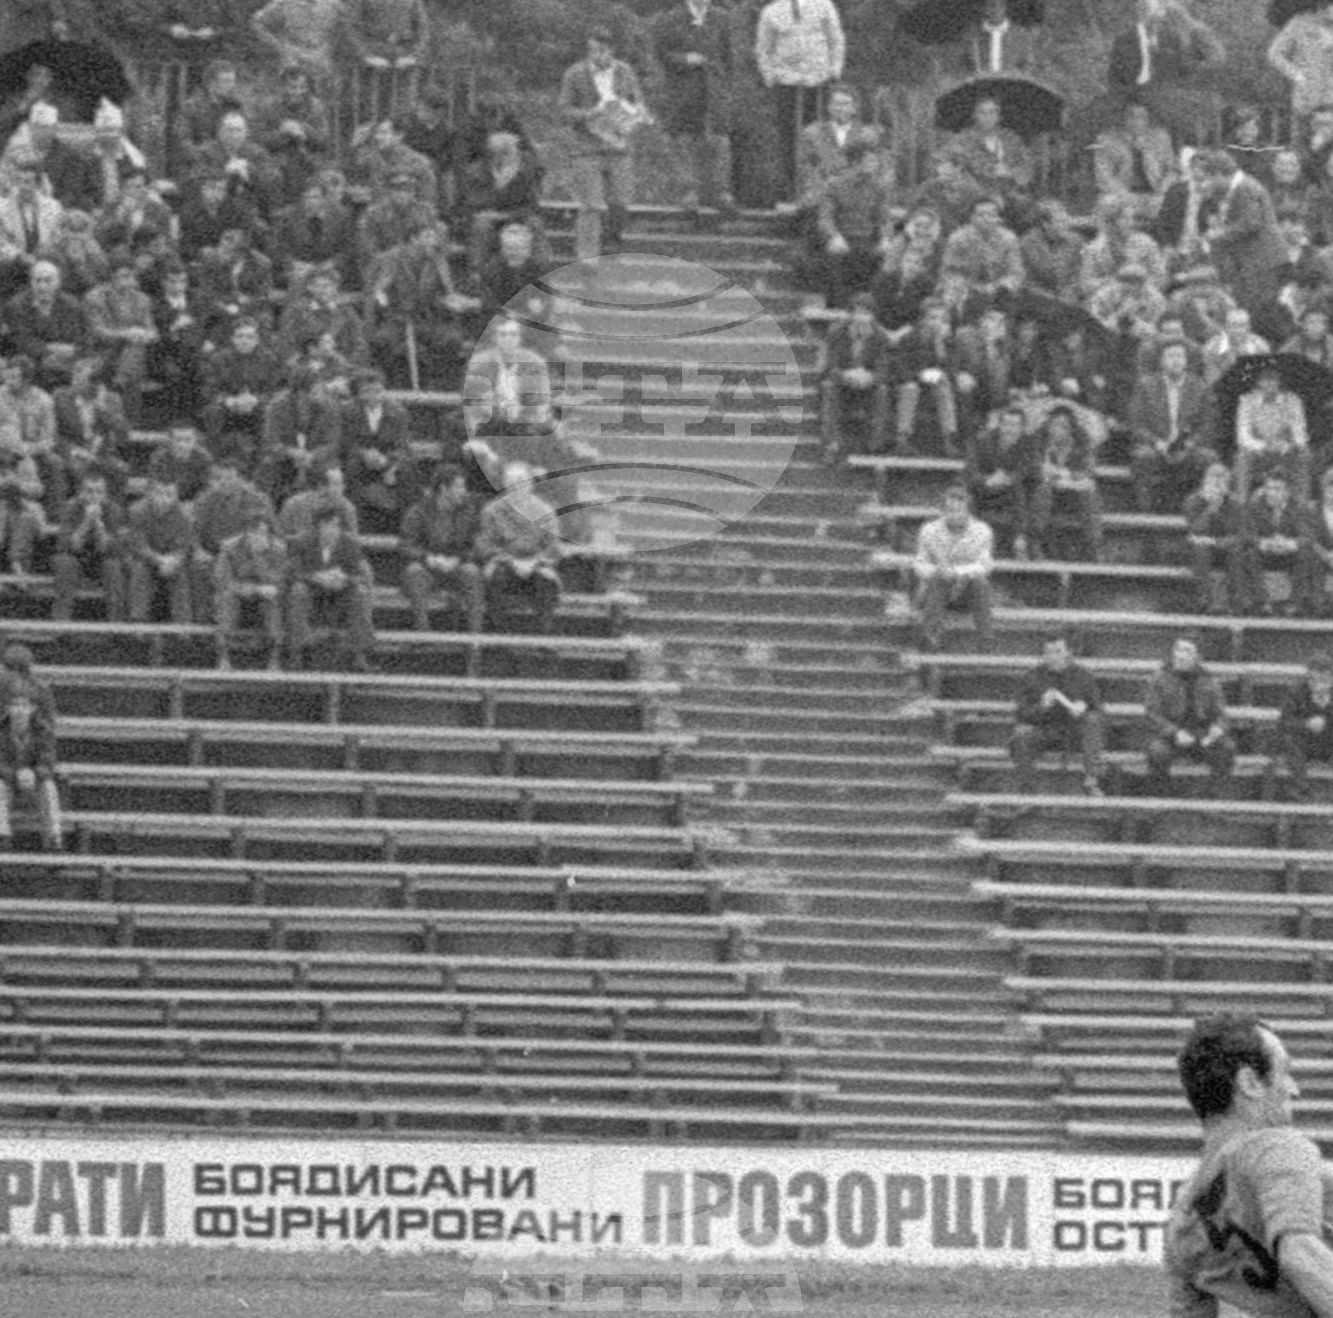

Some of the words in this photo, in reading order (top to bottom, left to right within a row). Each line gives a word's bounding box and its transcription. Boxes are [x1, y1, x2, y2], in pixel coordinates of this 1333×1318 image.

[193, 1163, 537, 1199] БОЯДИСАНИ
[193, 1205, 623, 1244] ФУРНИРОВАНИ
[642, 1170, 1029, 1250] ПРОЗОРЦИ
